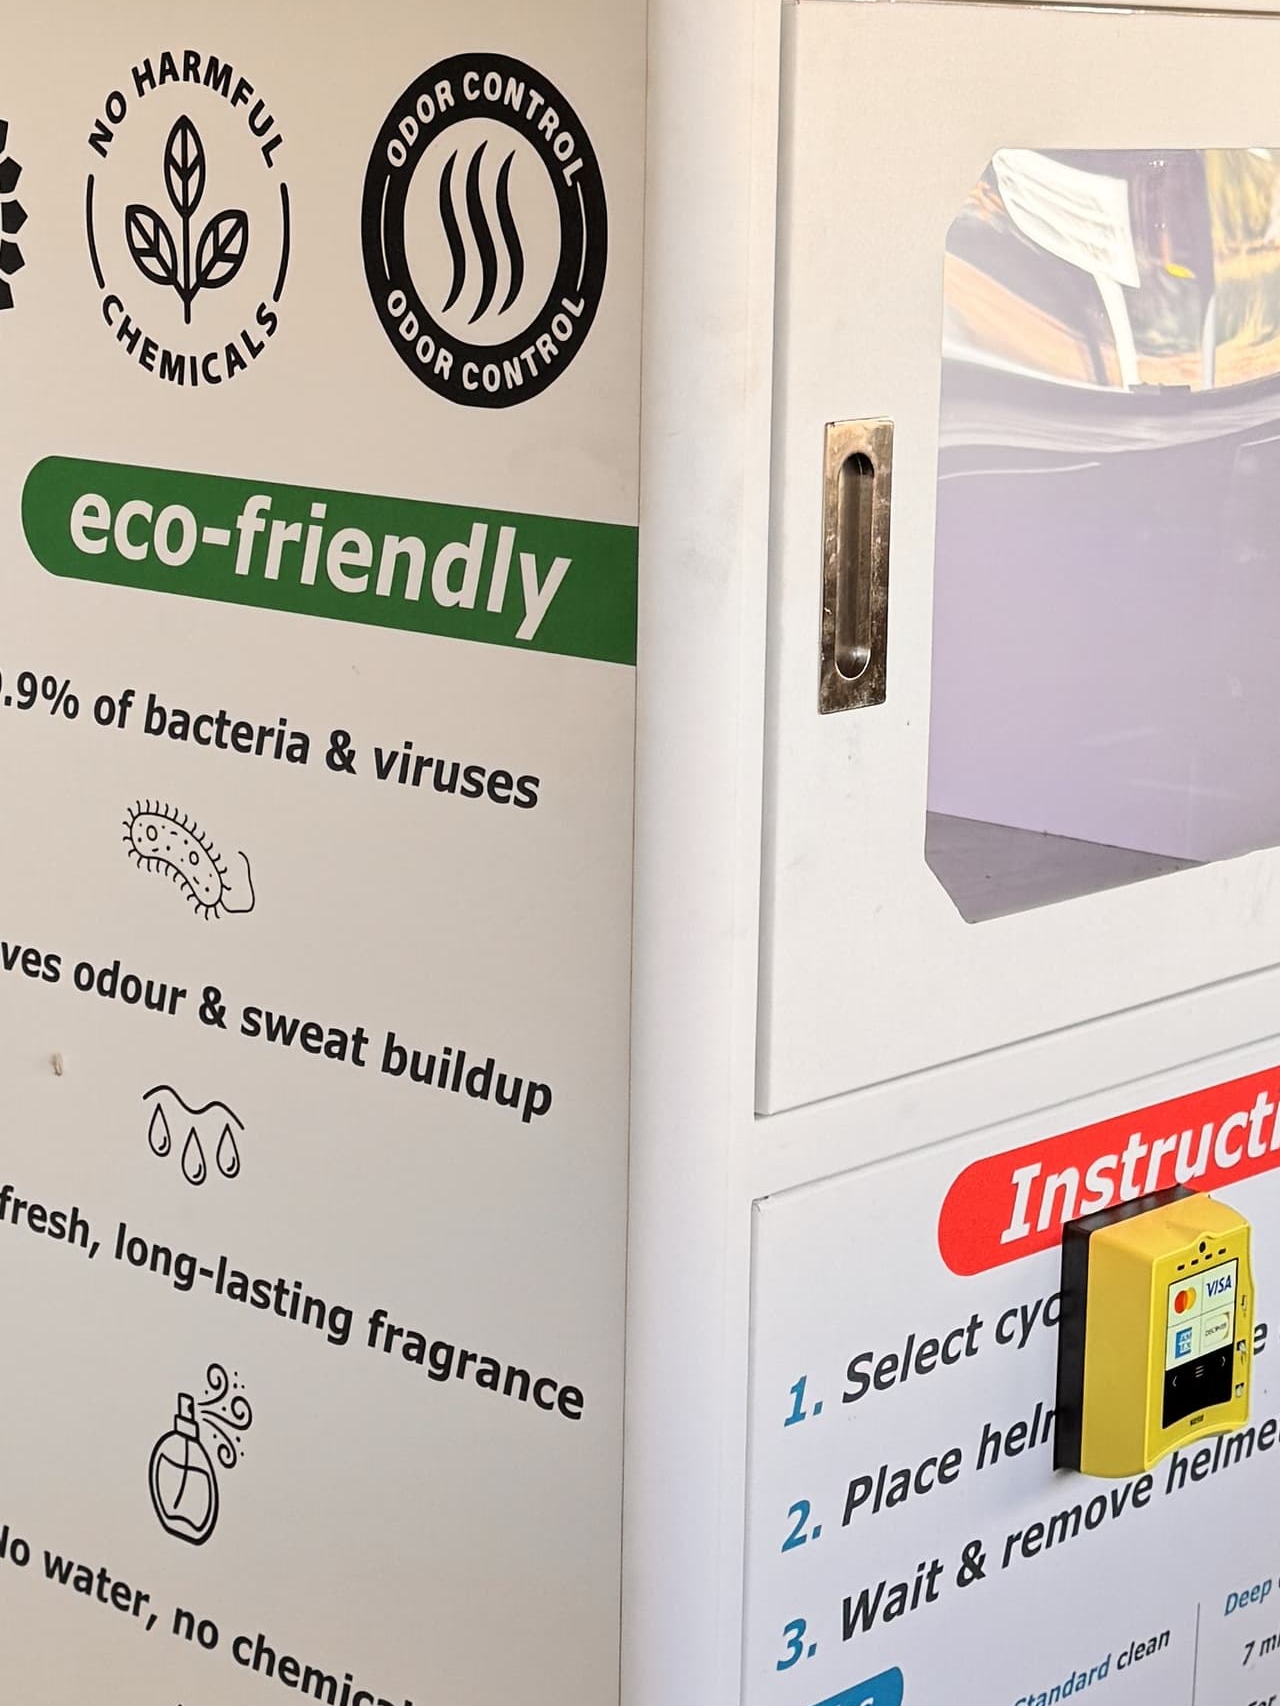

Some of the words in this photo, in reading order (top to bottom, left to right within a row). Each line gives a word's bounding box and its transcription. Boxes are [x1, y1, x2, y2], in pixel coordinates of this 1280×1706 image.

[87, 89, 130, 160] NO
[131, 49, 284, 170] HARMFUL
[385, 78, 456, 168] ODOR
[462, 71, 583, 188] CONTROL
[100, 294, 281, 387] CHEMICALS
[387, 289, 453, 382] ODOR
[460, 292, 585, 393] CONTROL
[68, 491, 572, 641] eco-friendly
[92, 689, 136, 730] of
[143, 693, 311, 766] bacteria
[325, 729, 358, 775] &
[372, 741, 542, 811] viruses
[73, 961, 188, 1019] odour
[198, 986, 228, 1030] &
[240, 1002, 369, 1067] sweat
[381, 1033, 554, 1124] buildup
[113, 1222, 354, 1348] long-lasting
[366, 1309, 586, 1421] fragrance
[1206, 1275, 1232, 1297] VISA
[784, 1377, 822, 1427] 1.
[842, 1313, 979, 1404] Select
[995, 1292, 1061, 1349] cyc
[781, 1501, 821, 1553] 2.
[841, 1447, 961, 1527] Place
[976, 1402, 1055, 1471] hel
[42, 1550, 158, 1630] water,
[171, 1603, 220, 1650] no
[776, 1621, 818, 1672] 3.
[840, 1559, 942, 1643] Wait
[957, 1540, 987, 1589] &
[1002, 1481, 1152, 1571] remove
[1224, 1577, 1272, 1616] Deep
[1116, 1629, 1170, 1672] clean
[1241, 1642, 1255, 1667] 7
